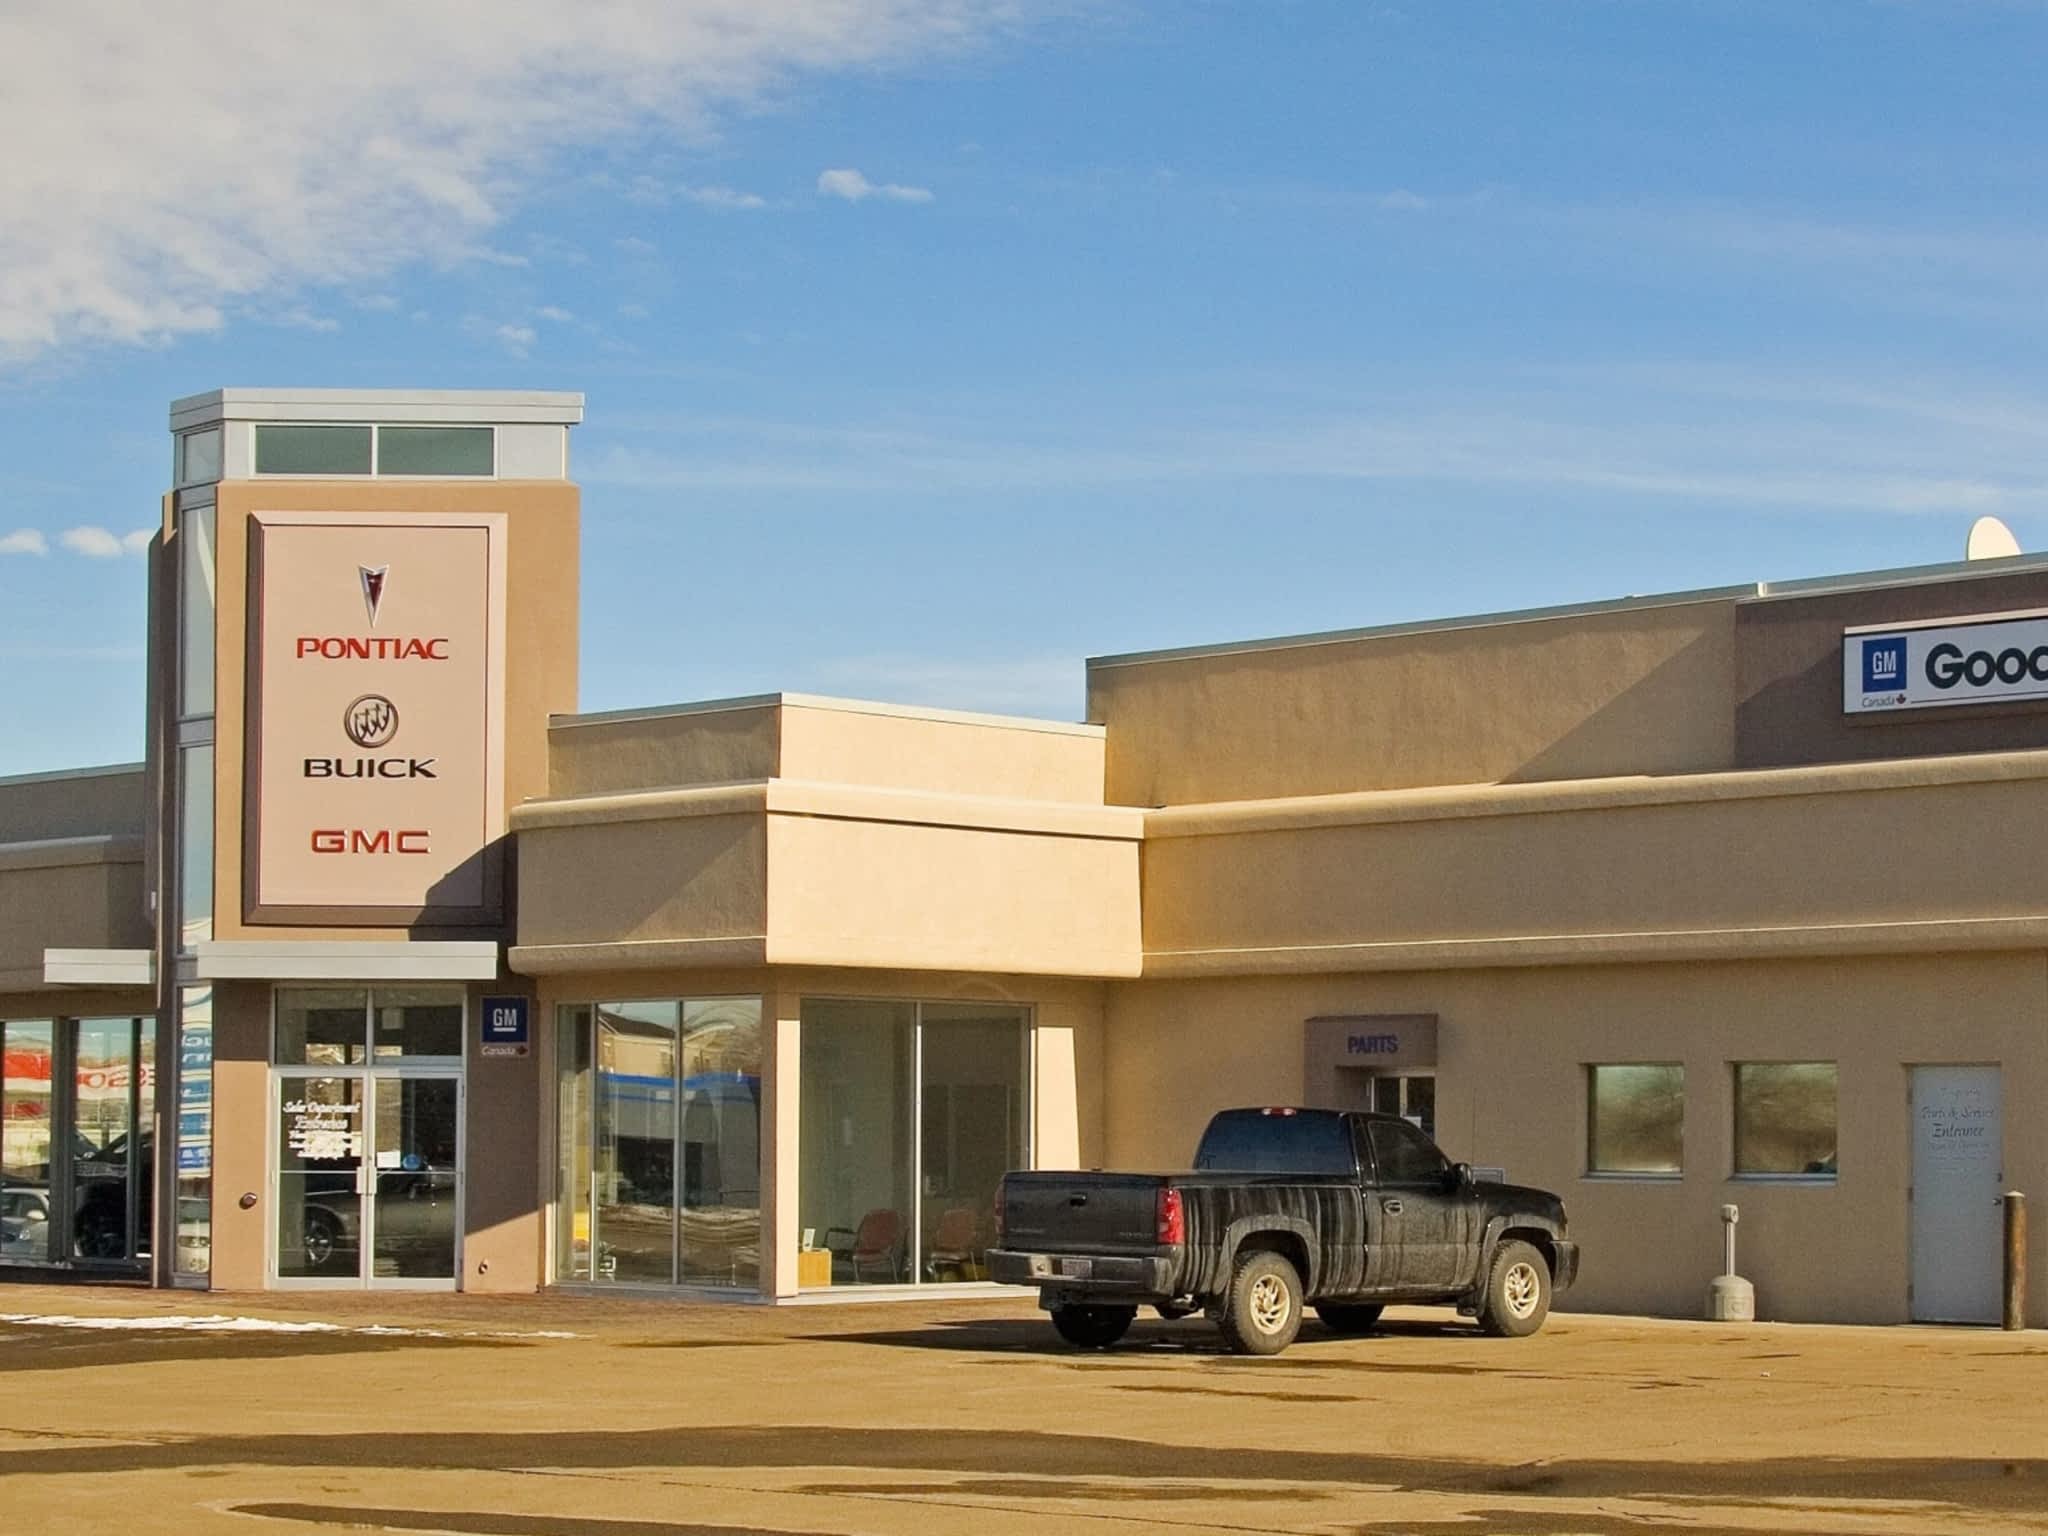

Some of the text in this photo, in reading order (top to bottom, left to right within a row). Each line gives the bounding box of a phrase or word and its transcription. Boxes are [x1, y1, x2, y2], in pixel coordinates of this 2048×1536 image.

[296, 637, 449, 660] PONTIAC
[1872, 650, 1897, 673] GM
[1861, 695, 1895, 708] Canada
[303, 758, 438, 778] BUICK
[310, 829, 431, 854] GMC
[493, 1008, 517, 1027] GM
[481, 1045, 516, 1056] Canada
[1347, 1034, 1399, 1055] PARTS
[1932, 1122, 1985, 1138] Entrance
